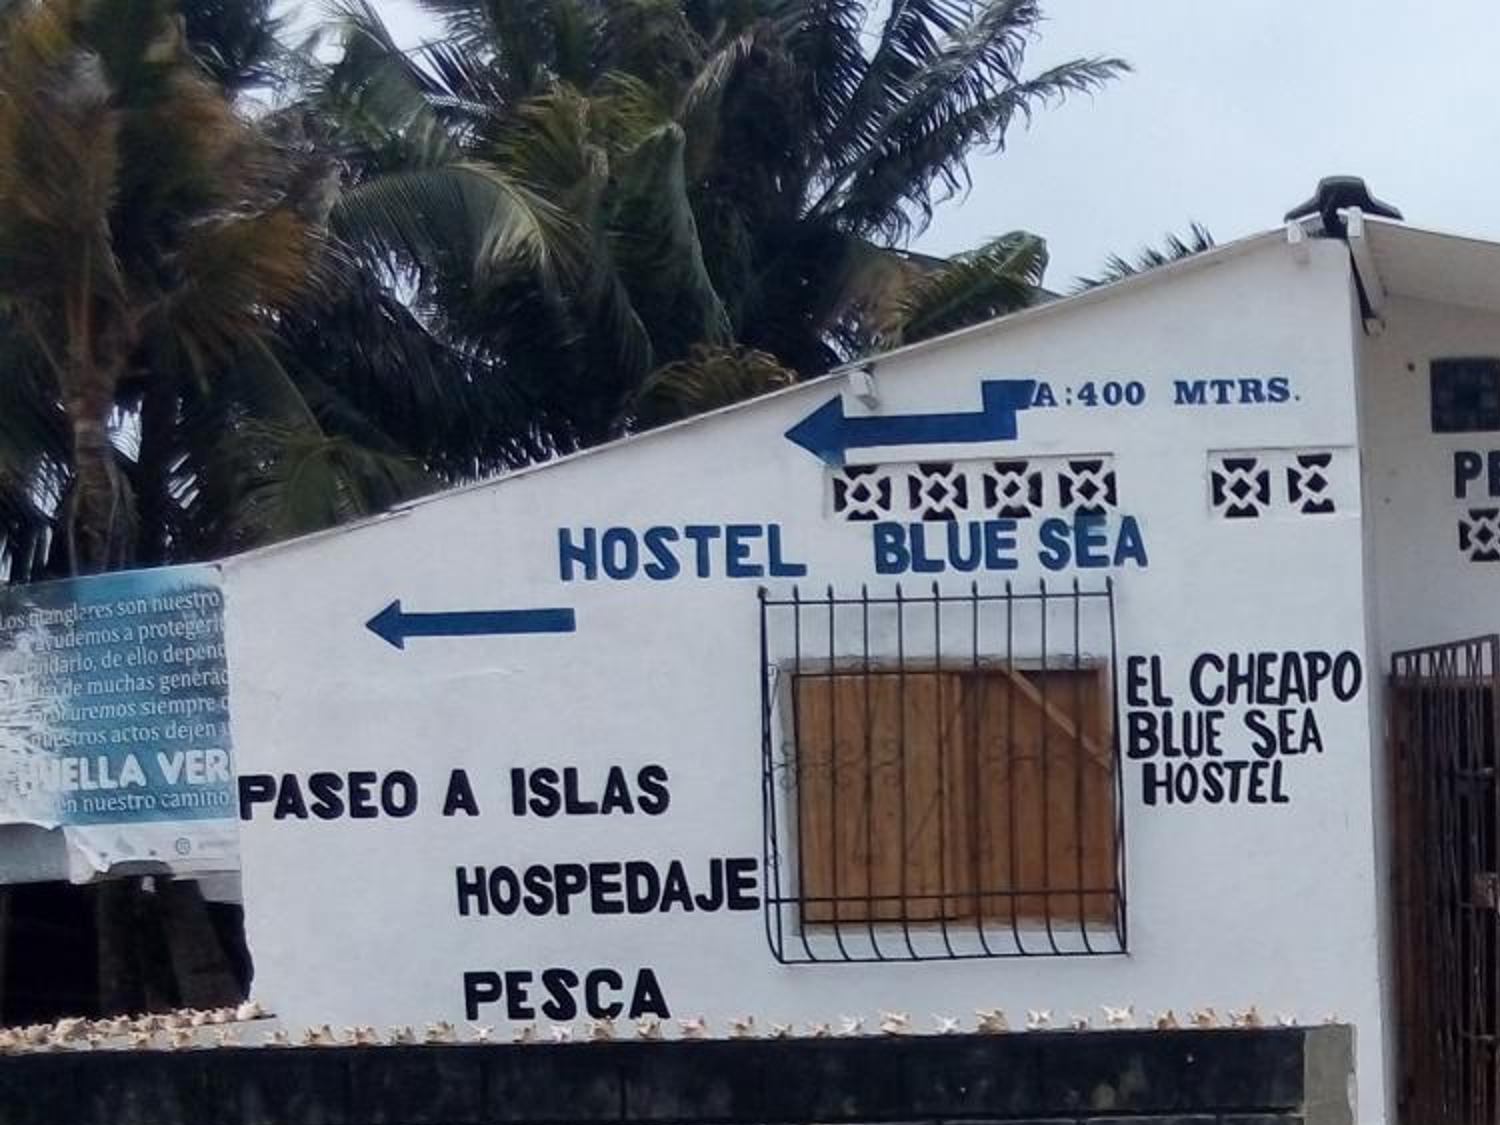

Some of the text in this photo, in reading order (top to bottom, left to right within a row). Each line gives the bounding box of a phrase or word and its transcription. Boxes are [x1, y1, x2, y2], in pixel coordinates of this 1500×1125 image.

[1173, 376, 1301, 406] MTRS.
[558, 514, 1149, 581] HOSTEL BLUE SEA
[115, 599, 147, 616] son
[152, 591, 220, 613] nuestro
[101, 650, 122, 669] de
[127, 644, 159, 667] ello
[87, 671, 155, 695] muchas
[1127, 651, 1363, 707] EL CHEAPO
[141, 696, 216, 718] siempre
[110, 724, 160, 743] actos
[164, 719, 217, 744] dejen
[1127, 708, 1323, 758] BLUE SEA
[30, 753, 147, 792] UELLA
[237, 764, 670, 820] PASEO A ISLAS
[1142, 759, 1290, 805] HOSTEL
[83, 793, 156, 813] nuestro
[161, 789, 229, 808] camino
[456, 858, 760, 916] HOSPEDAJE
[464, 968, 671, 1020] PESCA
